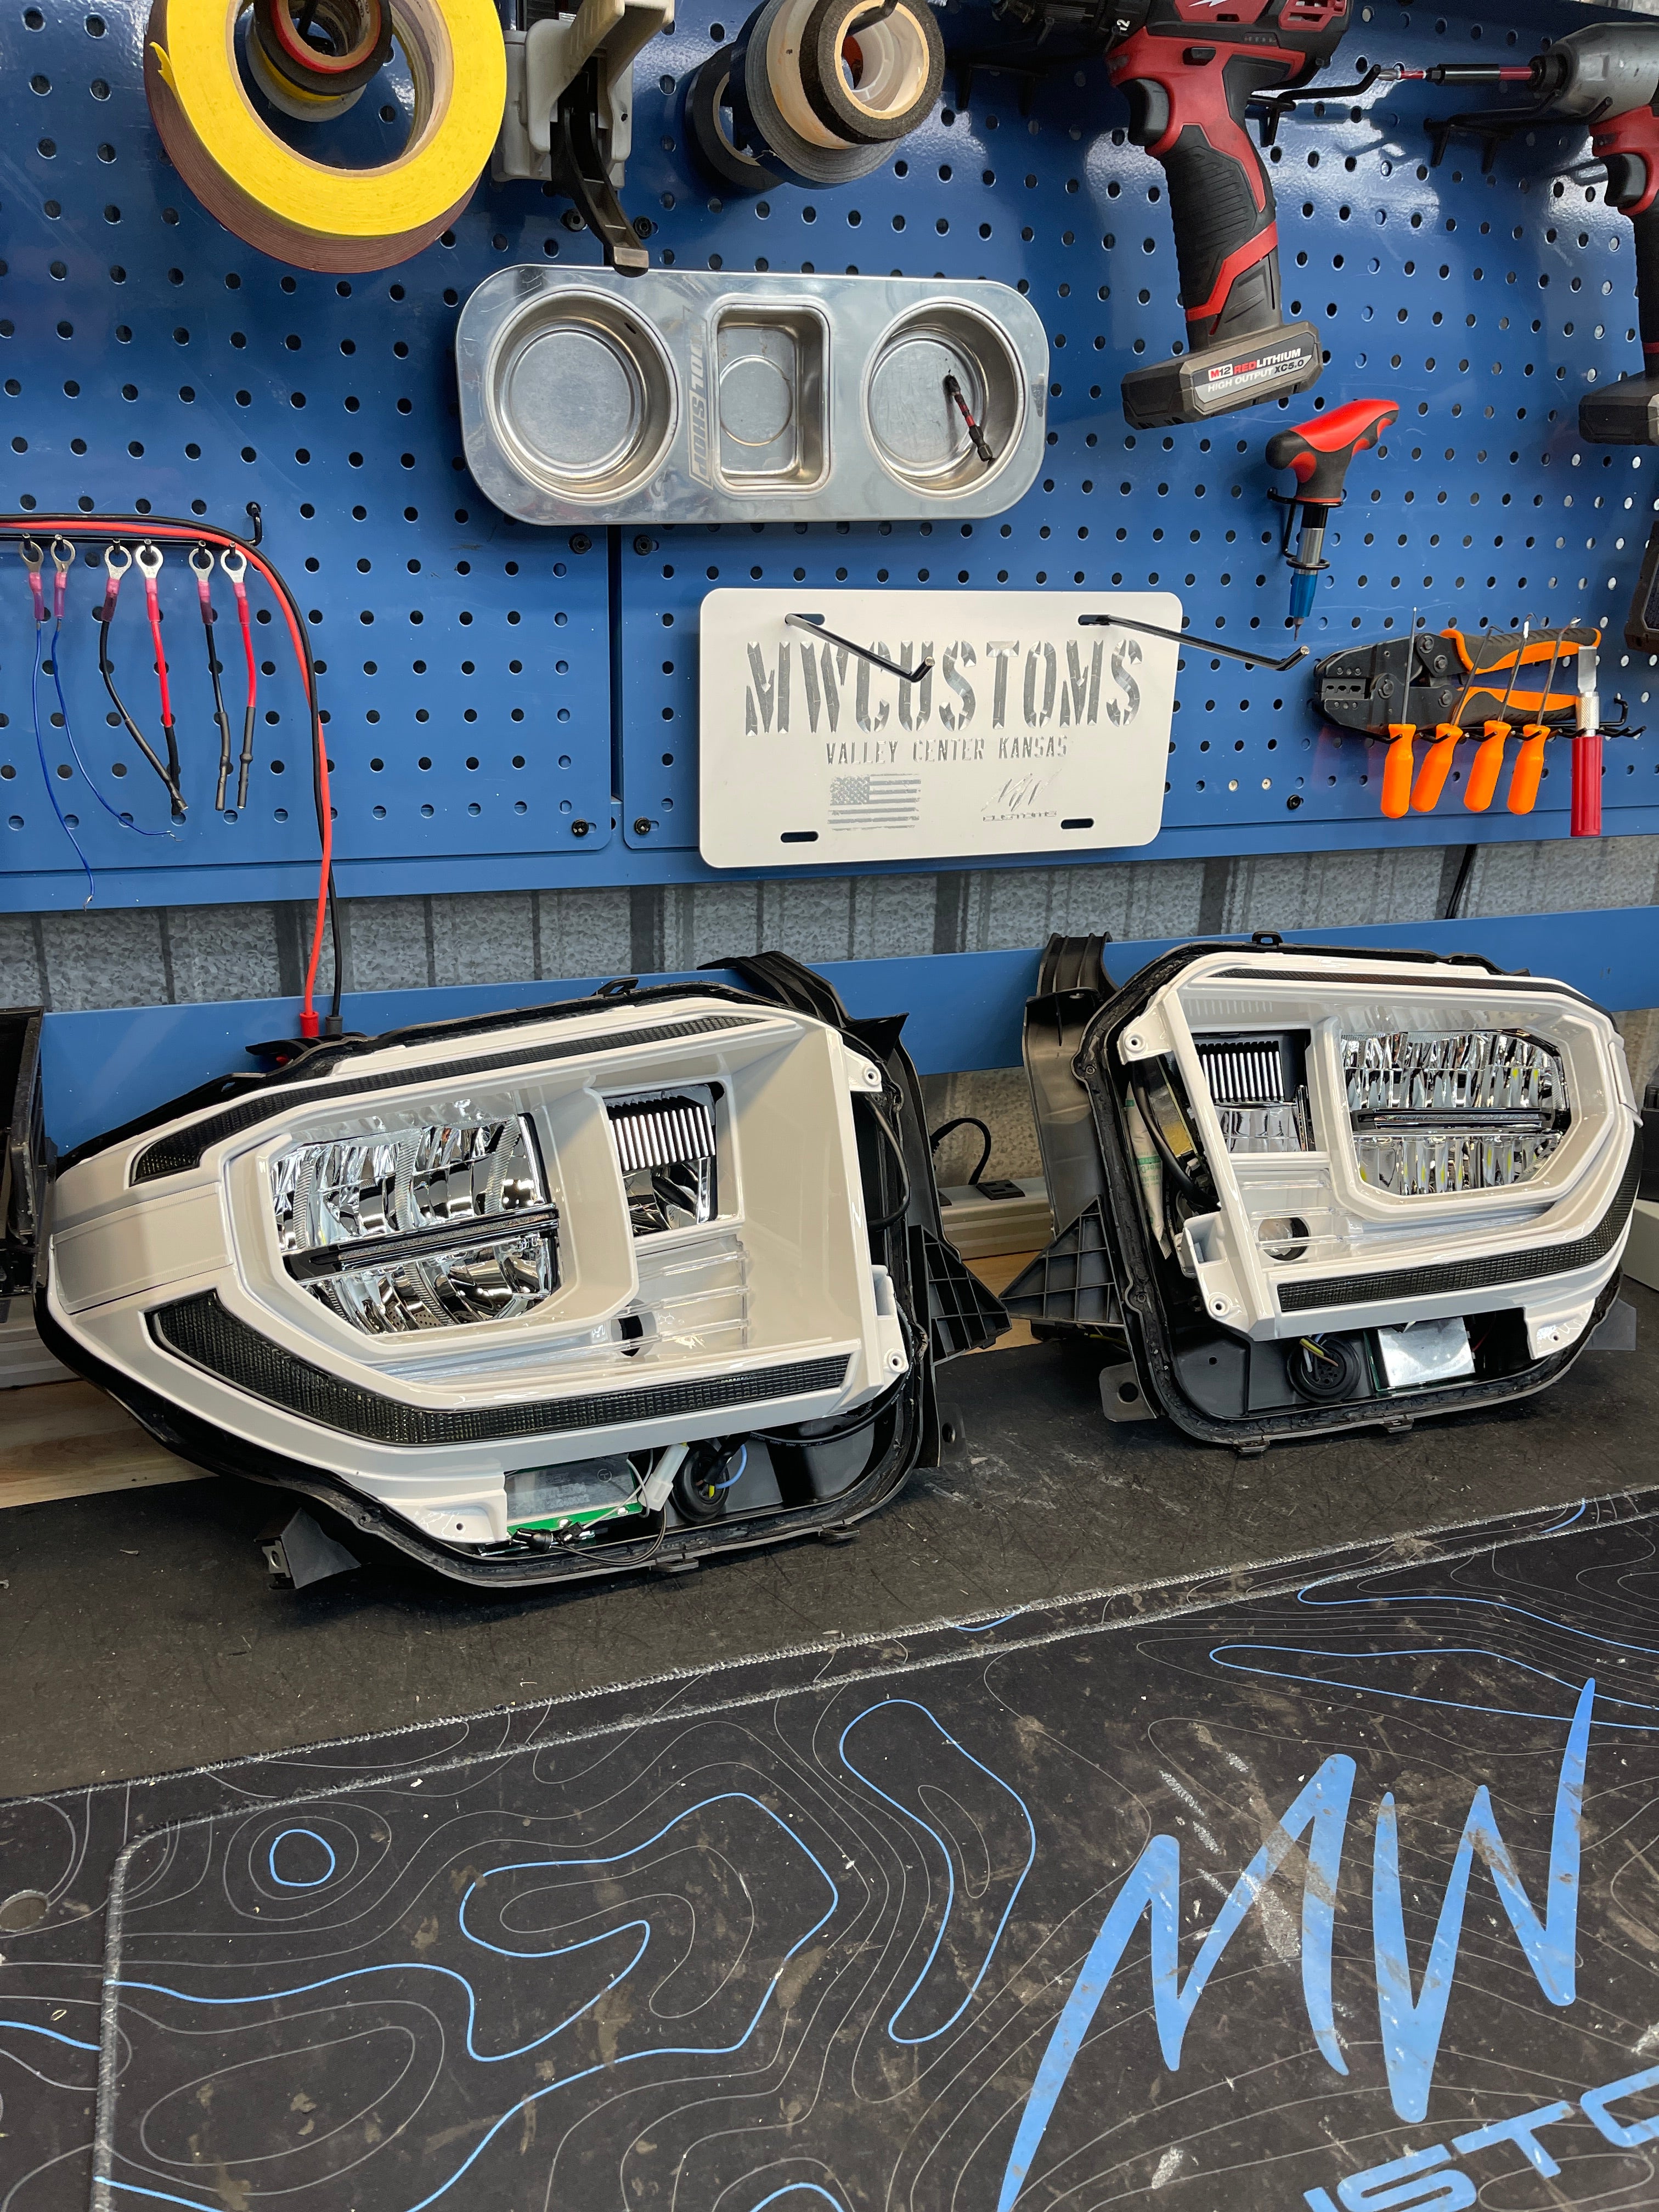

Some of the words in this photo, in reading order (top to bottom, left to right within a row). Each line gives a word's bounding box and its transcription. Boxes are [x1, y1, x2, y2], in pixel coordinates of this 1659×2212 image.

[1207, 379, 1233, 392] HIGH
[1234, 367, 1274, 384] OUTPUT
[1274, 359, 1304, 374] XC5.0
[1210, 366, 1231, 379] M12
[1234, 348, 1301, 374] REDLITHIUM
[692, 393, 708, 477] SHOP
[826, 740, 899, 765] VALLEY
[912, 737, 985, 763] CENTER
[998, 734, 1068, 759] KANSAS
